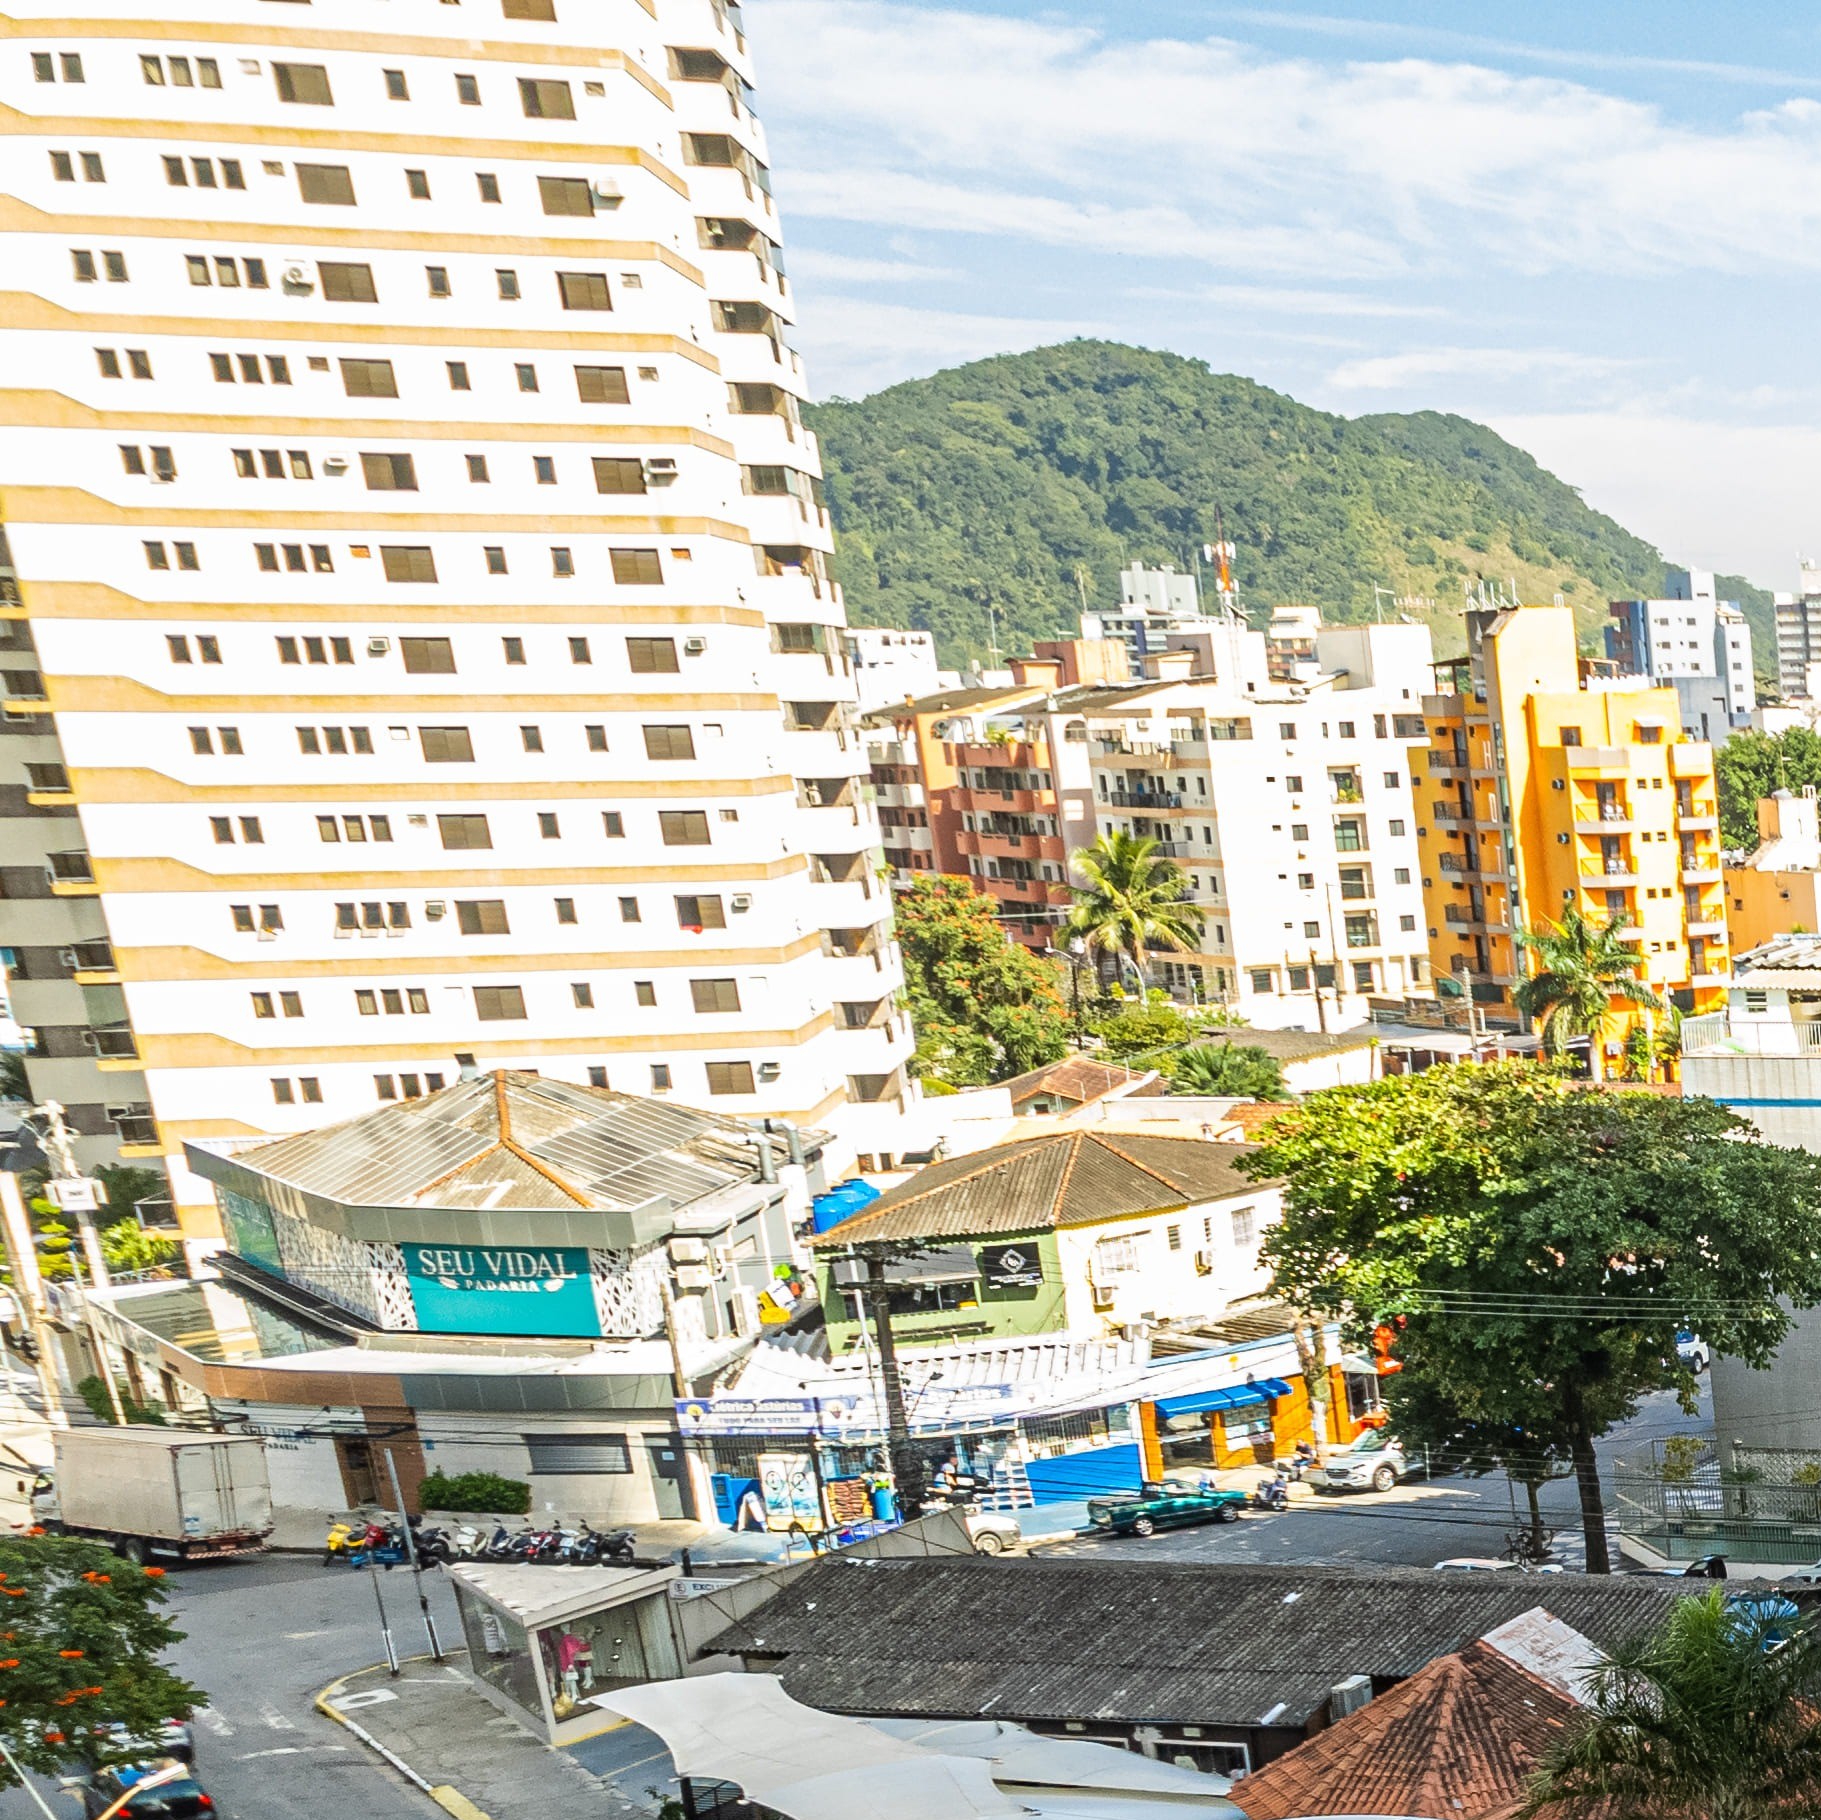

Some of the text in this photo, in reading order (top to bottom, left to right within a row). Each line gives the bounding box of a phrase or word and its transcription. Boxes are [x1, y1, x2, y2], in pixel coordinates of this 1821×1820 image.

[418, 1249, 578, 1279] SEU VIDAL
[465, 1279, 541, 1293] PADARIA
